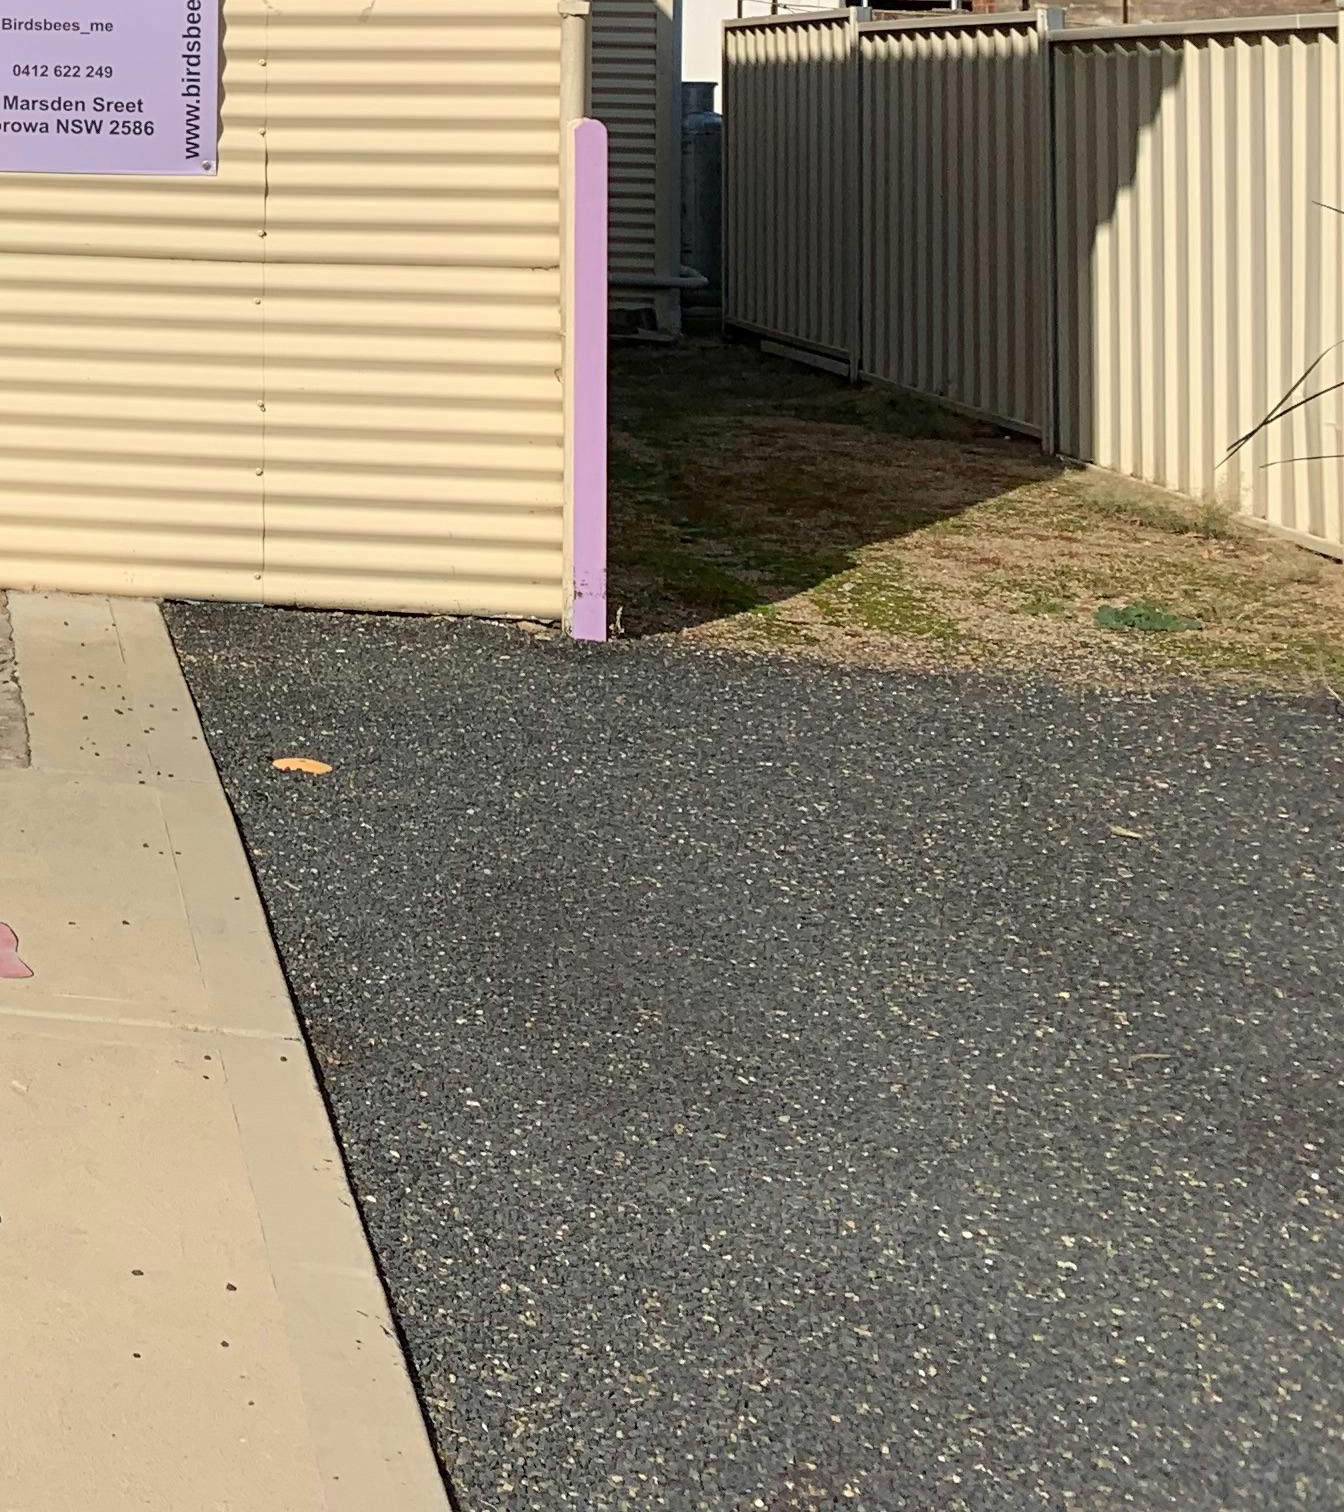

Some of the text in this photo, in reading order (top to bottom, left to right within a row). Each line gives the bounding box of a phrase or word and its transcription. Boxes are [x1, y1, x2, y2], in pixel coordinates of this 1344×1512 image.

[1, 18, 114, 34] Birdsbees_me
[13, 64, 113, 78] 0412 622 249
[3, 95, 86, 112] Marsden
[92, 97, 144, 113] Sreet
[56, 119, 104, 134] NSW
[109, 120, 155, 136] 2586
